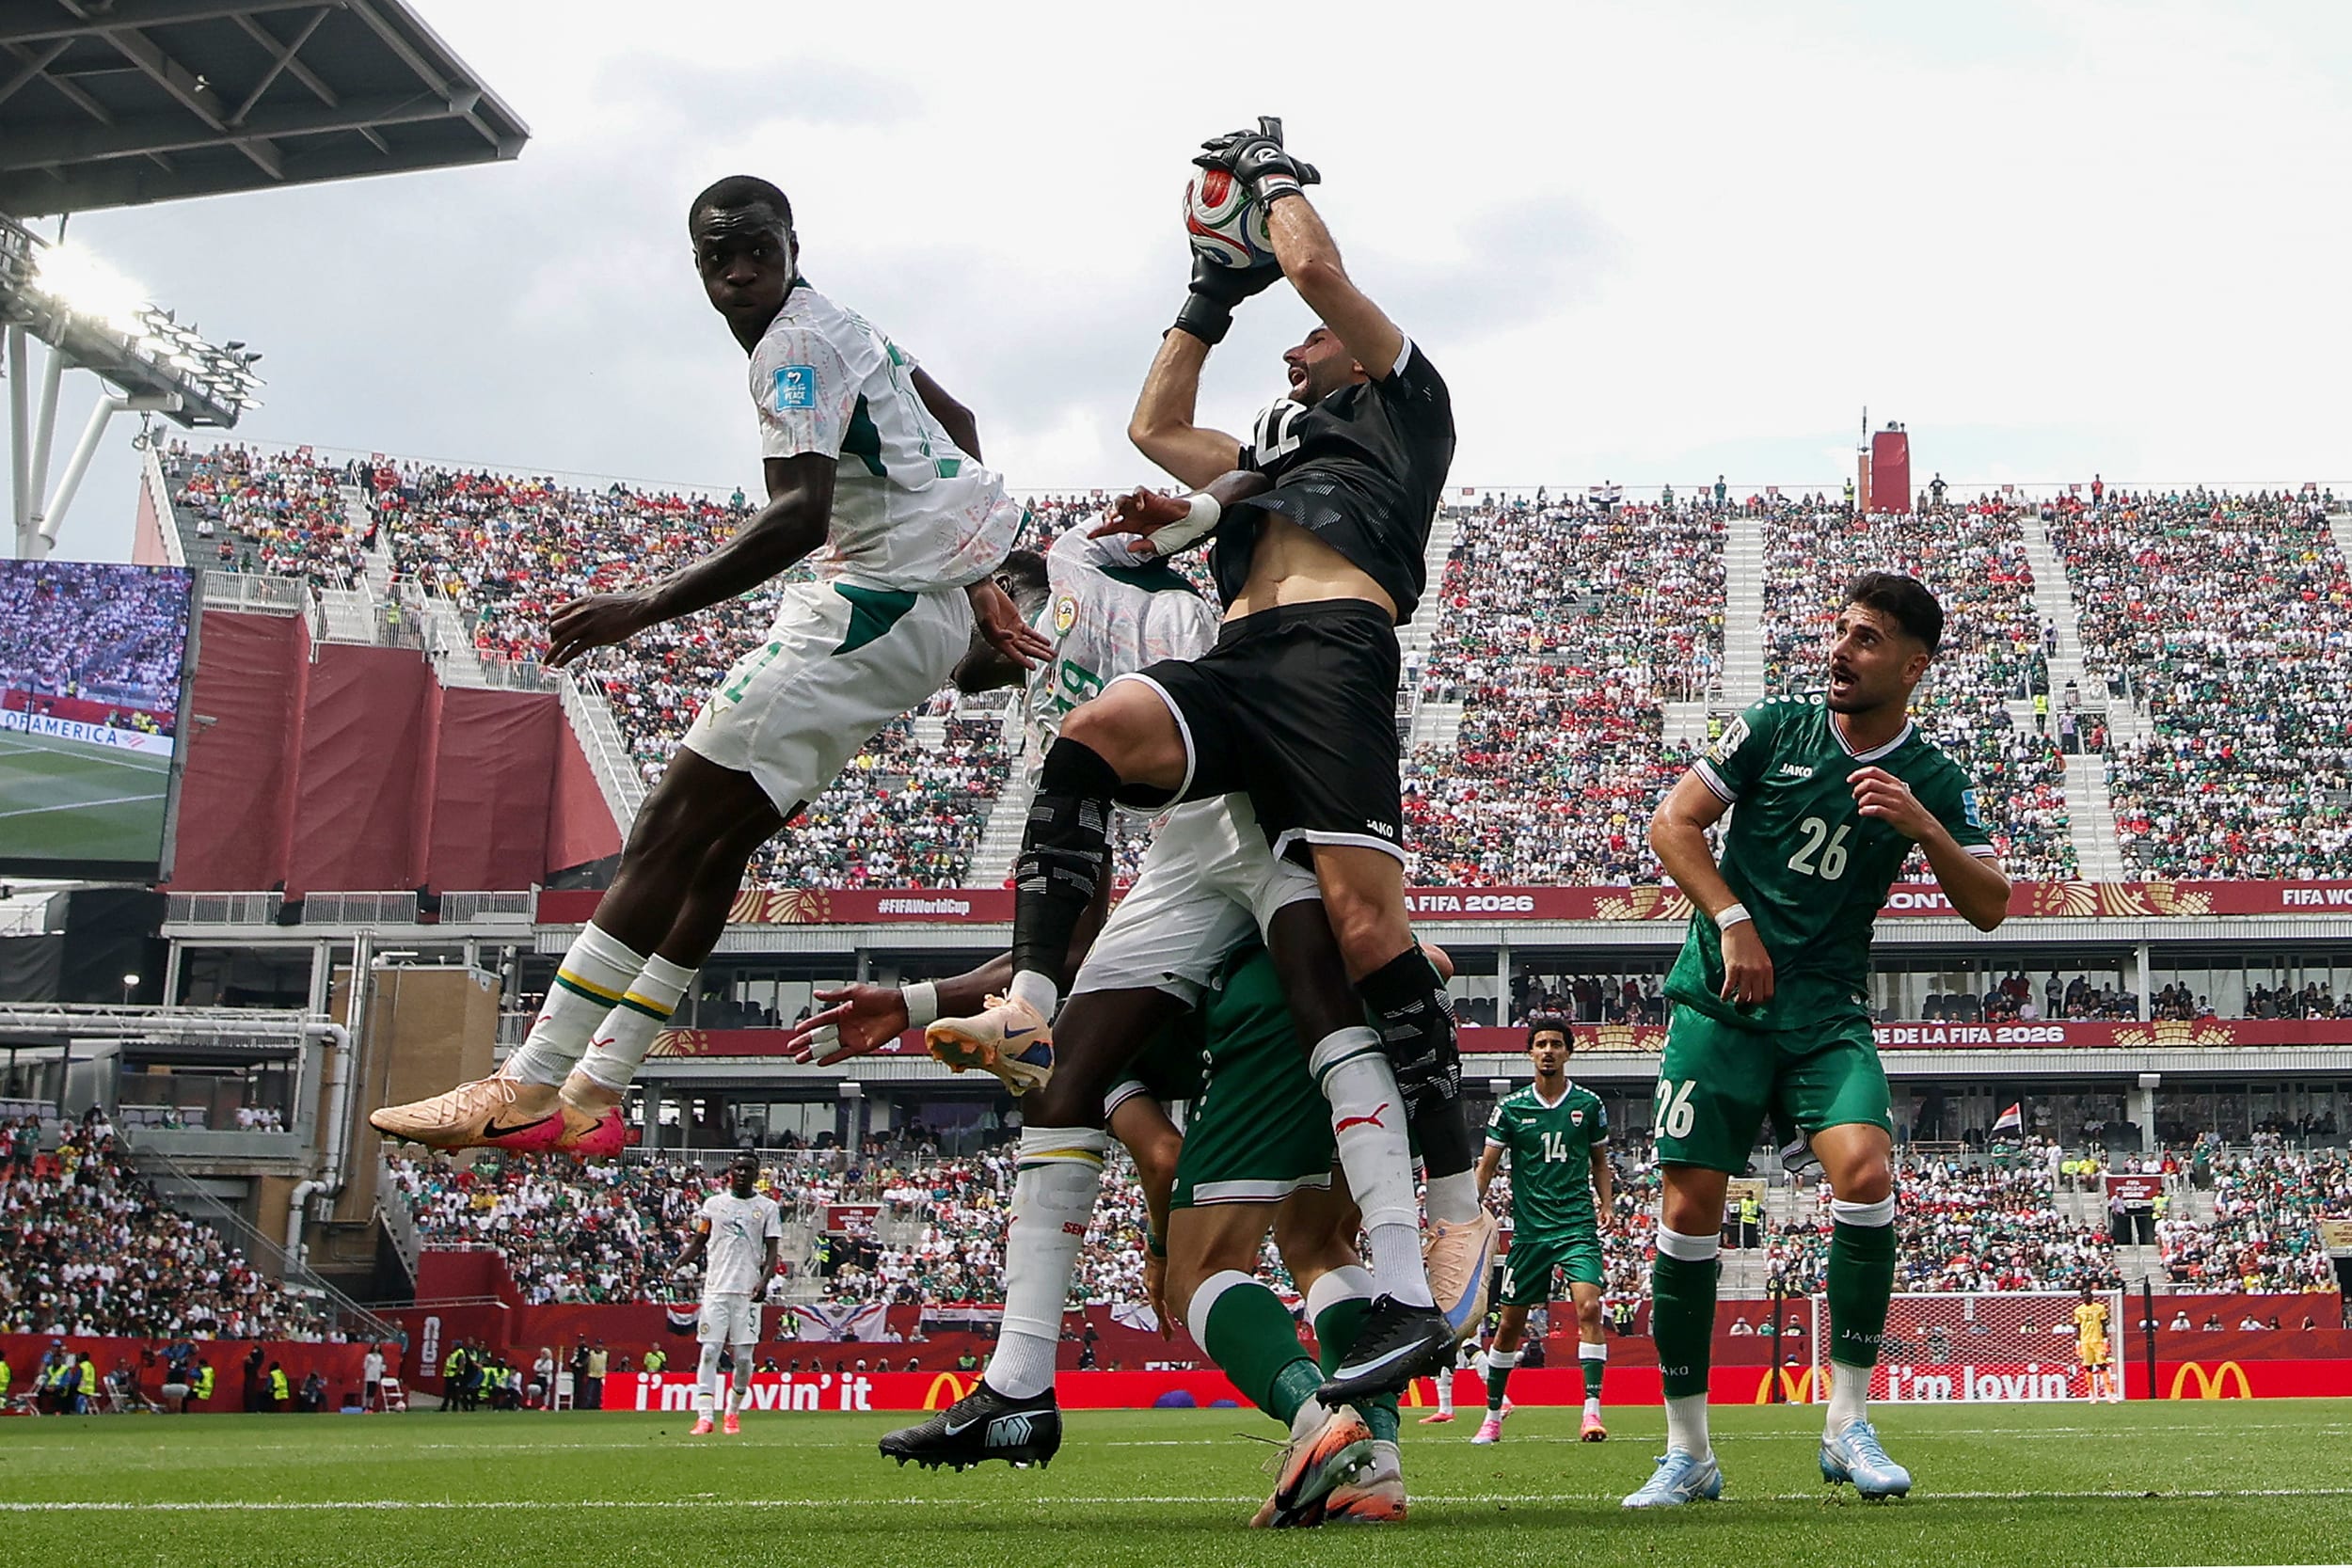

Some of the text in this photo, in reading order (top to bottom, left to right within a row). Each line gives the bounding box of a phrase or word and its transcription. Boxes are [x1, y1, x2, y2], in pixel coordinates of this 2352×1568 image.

[31, 717, 118, 745] AMERICA
[1779, 762, 1814, 778] JAKO
[1788, 816, 1852, 880] 26
[878, 898, 970, 916] #FIFAWorldCup
[1419, 895, 1462, 911] FIFA
[1465, 895, 1534, 911] 2026
[2282, 889, 2325, 905] FIFA
[1893, 1028, 1913, 1043] DE
[1922, 1028, 1945, 1043] LA
[1950, 1028, 1994, 1043] FIFA
[1996, 1026, 2064, 1043] 2026
[1654, 1079, 1697, 1139] 26
[1541, 1131, 1567, 1164] 14
[1841, 1329, 1882, 1343] JAKO
[635, 1371, 700, 1410] i'm
[840, 1371, 872, 1410] it
[1888, 1365, 1952, 1401] i'm
[1963, 1363, 2077, 1401] lovin'
